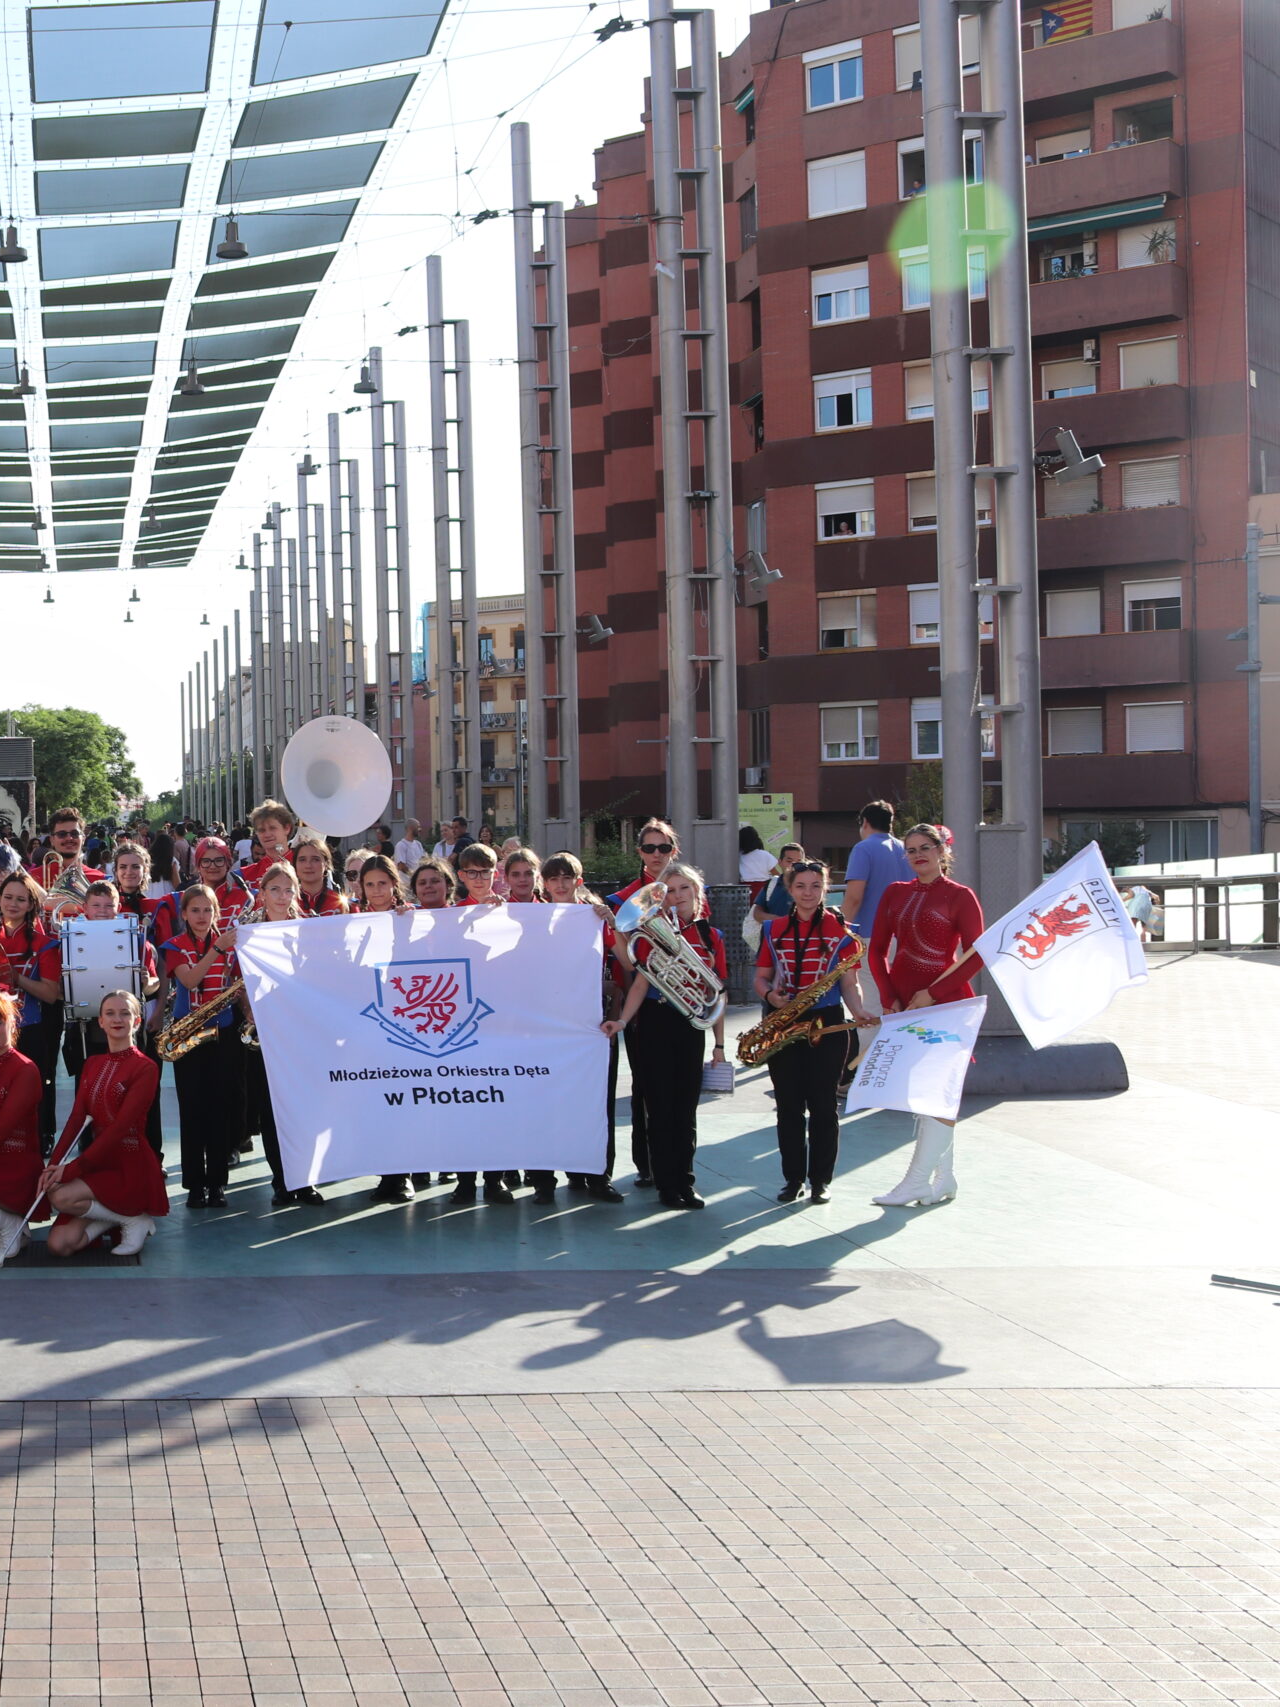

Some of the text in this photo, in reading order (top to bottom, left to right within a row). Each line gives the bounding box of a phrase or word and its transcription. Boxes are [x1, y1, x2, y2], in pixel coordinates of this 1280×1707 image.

[329, 1065, 550, 1082] Młodzieżowa Orkiestra Dęta
[858, 1038, 890, 1087] Zachodnie
[873, 1044, 903, 1088] Pomorze
[384, 1085, 505, 1106] w Płotach
